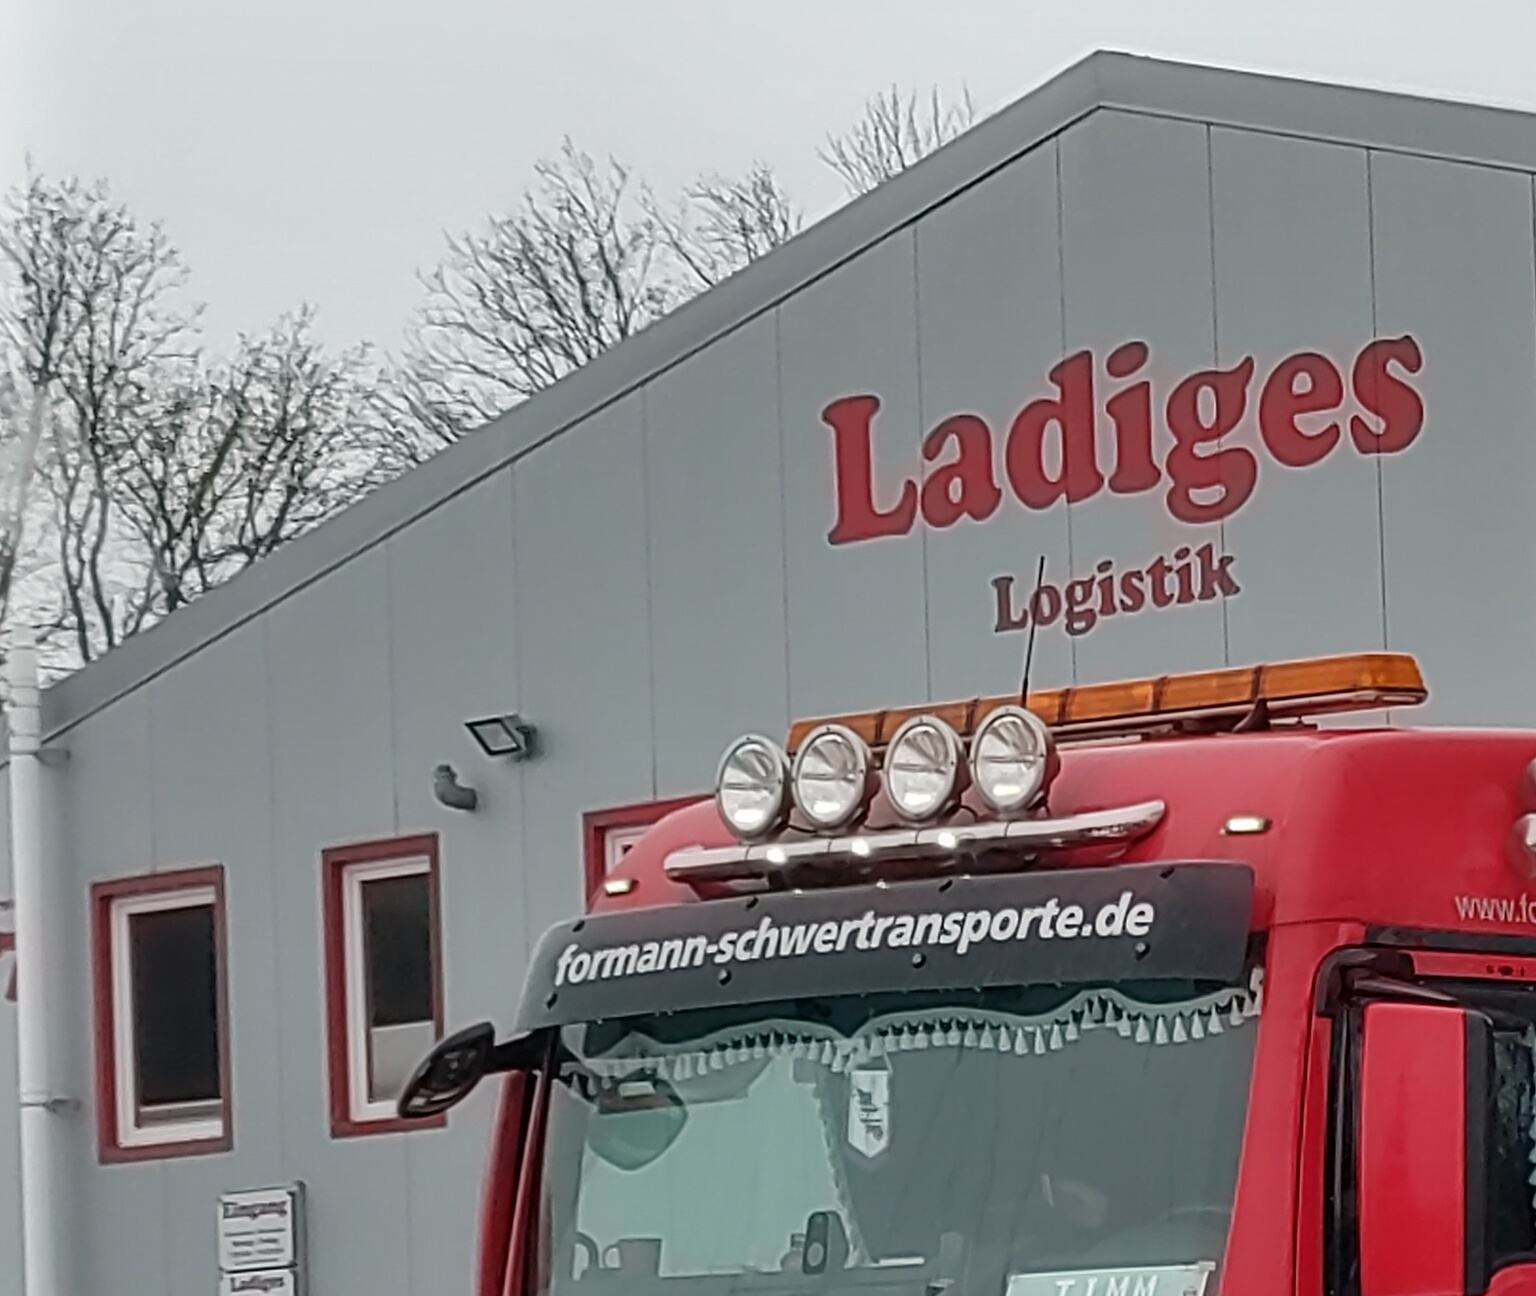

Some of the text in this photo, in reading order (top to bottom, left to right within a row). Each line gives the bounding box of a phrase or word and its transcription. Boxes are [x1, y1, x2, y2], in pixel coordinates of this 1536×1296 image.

[822, 335, 1424, 545] Ladiges
[992, 543, 1241, 637] Logistik
[554, 891, 1155, 987] formann-schwertransporte.de
